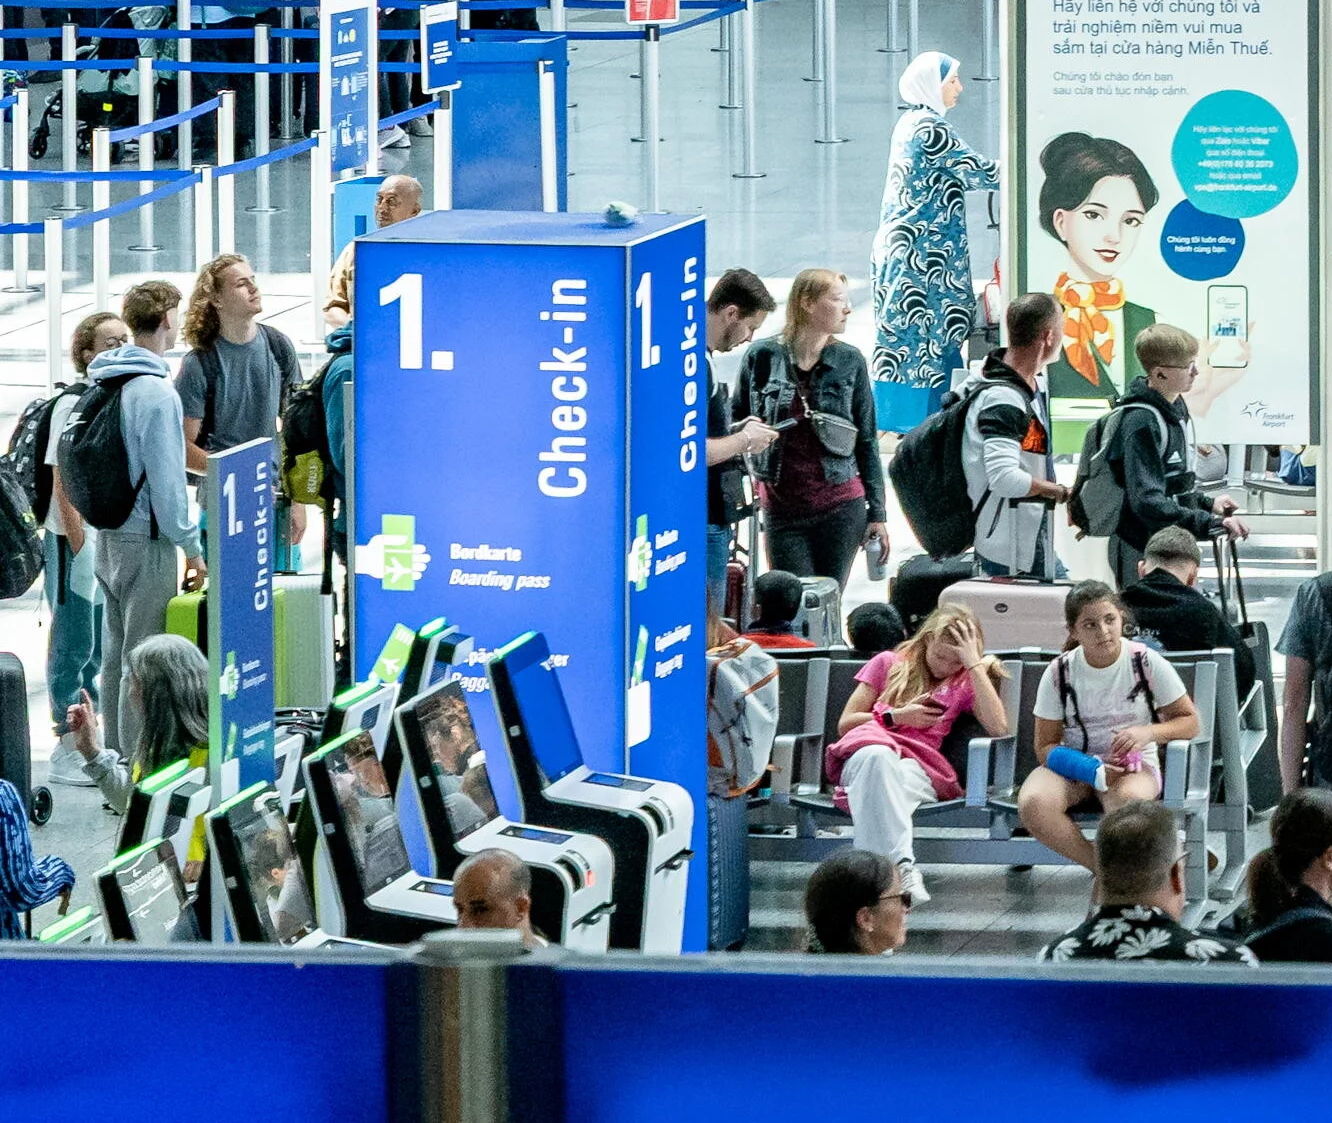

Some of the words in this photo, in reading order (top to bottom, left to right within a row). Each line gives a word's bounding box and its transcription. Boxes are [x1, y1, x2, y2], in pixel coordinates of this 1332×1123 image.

[1054, 0, 1082, 16] Hãy
[1088, 0, 1113, 12] liên
[1119, 0, 1137, 15] hệ
[1143, 0, 1163, 12] với
[1169, 0, 1214, 16] chúng
[1220, 0, 1237, 13] tôi
[1243, 0, 1260, 13] và
[1184, 21, 1204, 33] vui
[1210, 24, 1242, 33] mua
[379, 273, 455, 371] 1.
[635, 272, 661, 370] 1.
[678, 255, 699, 473] Check-in
[537, 279, 588, 499] Check-in
[1262, 411, 1295, 421] Frankfurt
[1262, 419, 1287, 429] Airport
[223, 473, 244, 537] 1.
[254, 461, 268, 612] Check-in
[449, 542, 523, 563] Bordkarte
[449, 568, 513, 591] Boarding
[514, 574, 552, 592] pass
